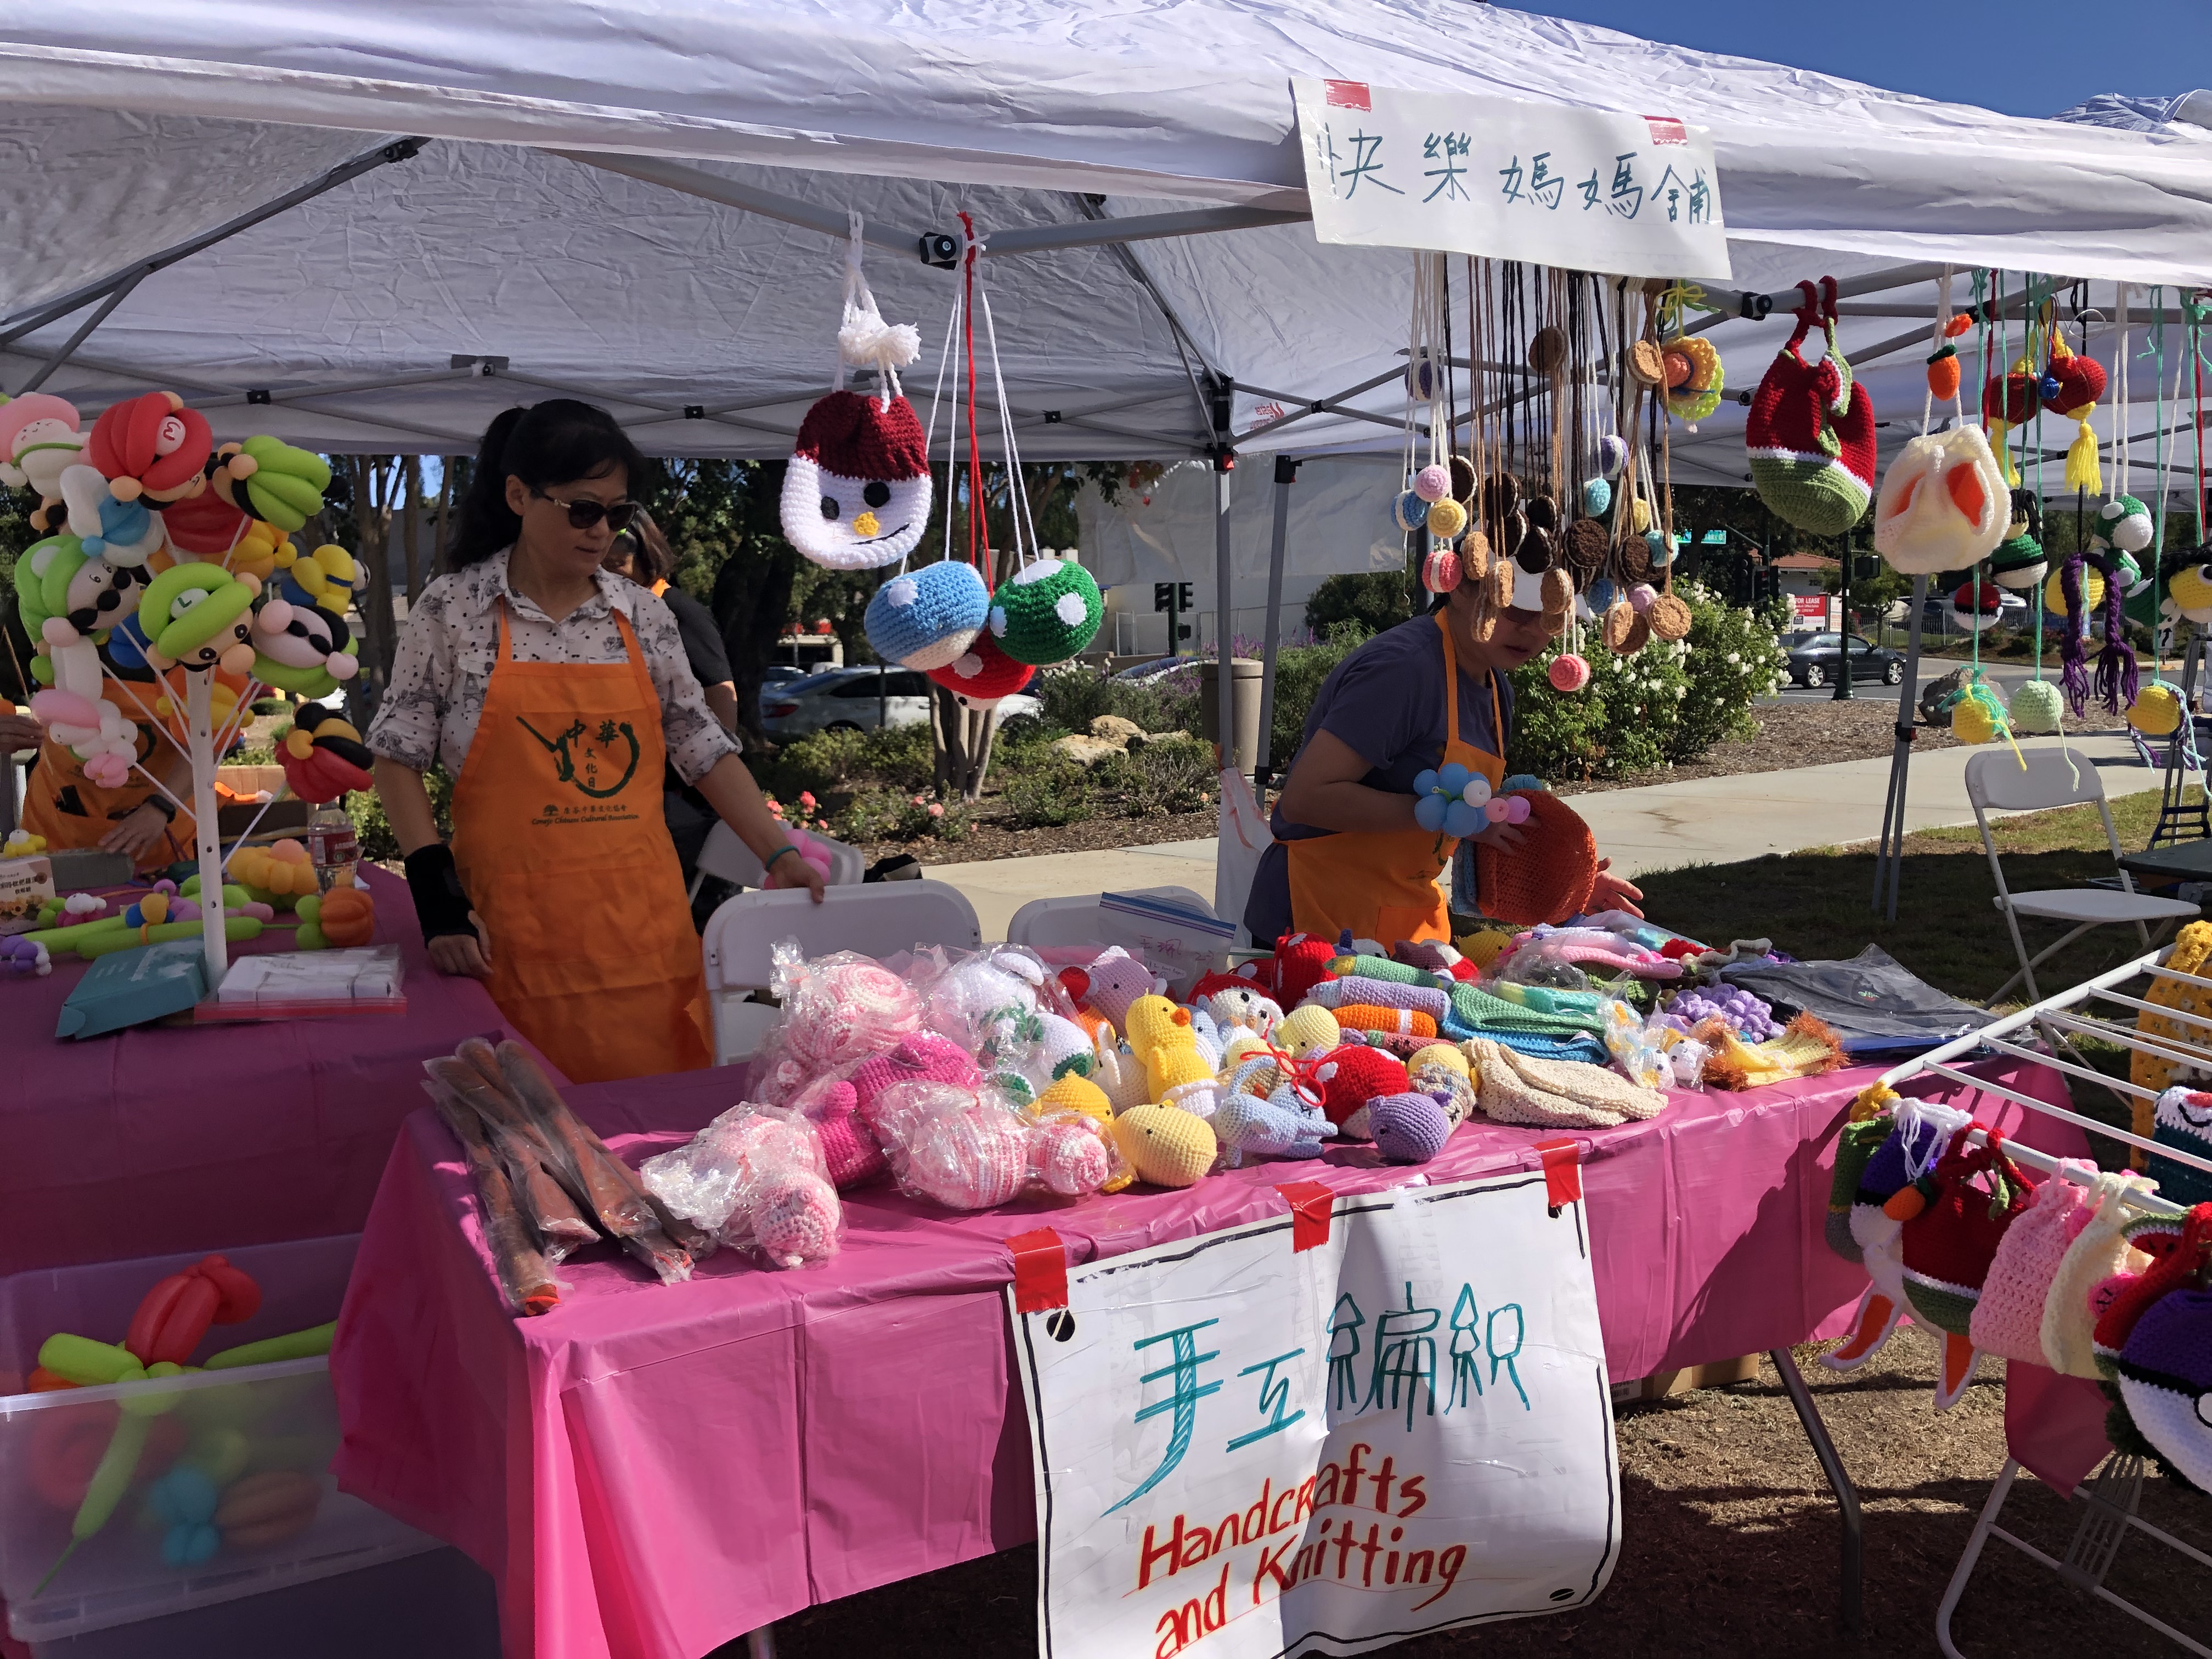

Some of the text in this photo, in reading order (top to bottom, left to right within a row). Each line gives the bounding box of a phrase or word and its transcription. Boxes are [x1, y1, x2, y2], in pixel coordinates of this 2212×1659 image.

[178, 597, 193, 608] L
[566, 719, 619, 748] 中華
[1138, 1443, 1426, 1590] Handcrafts
[1155, 1518, 1467, 1659] and Knitting
